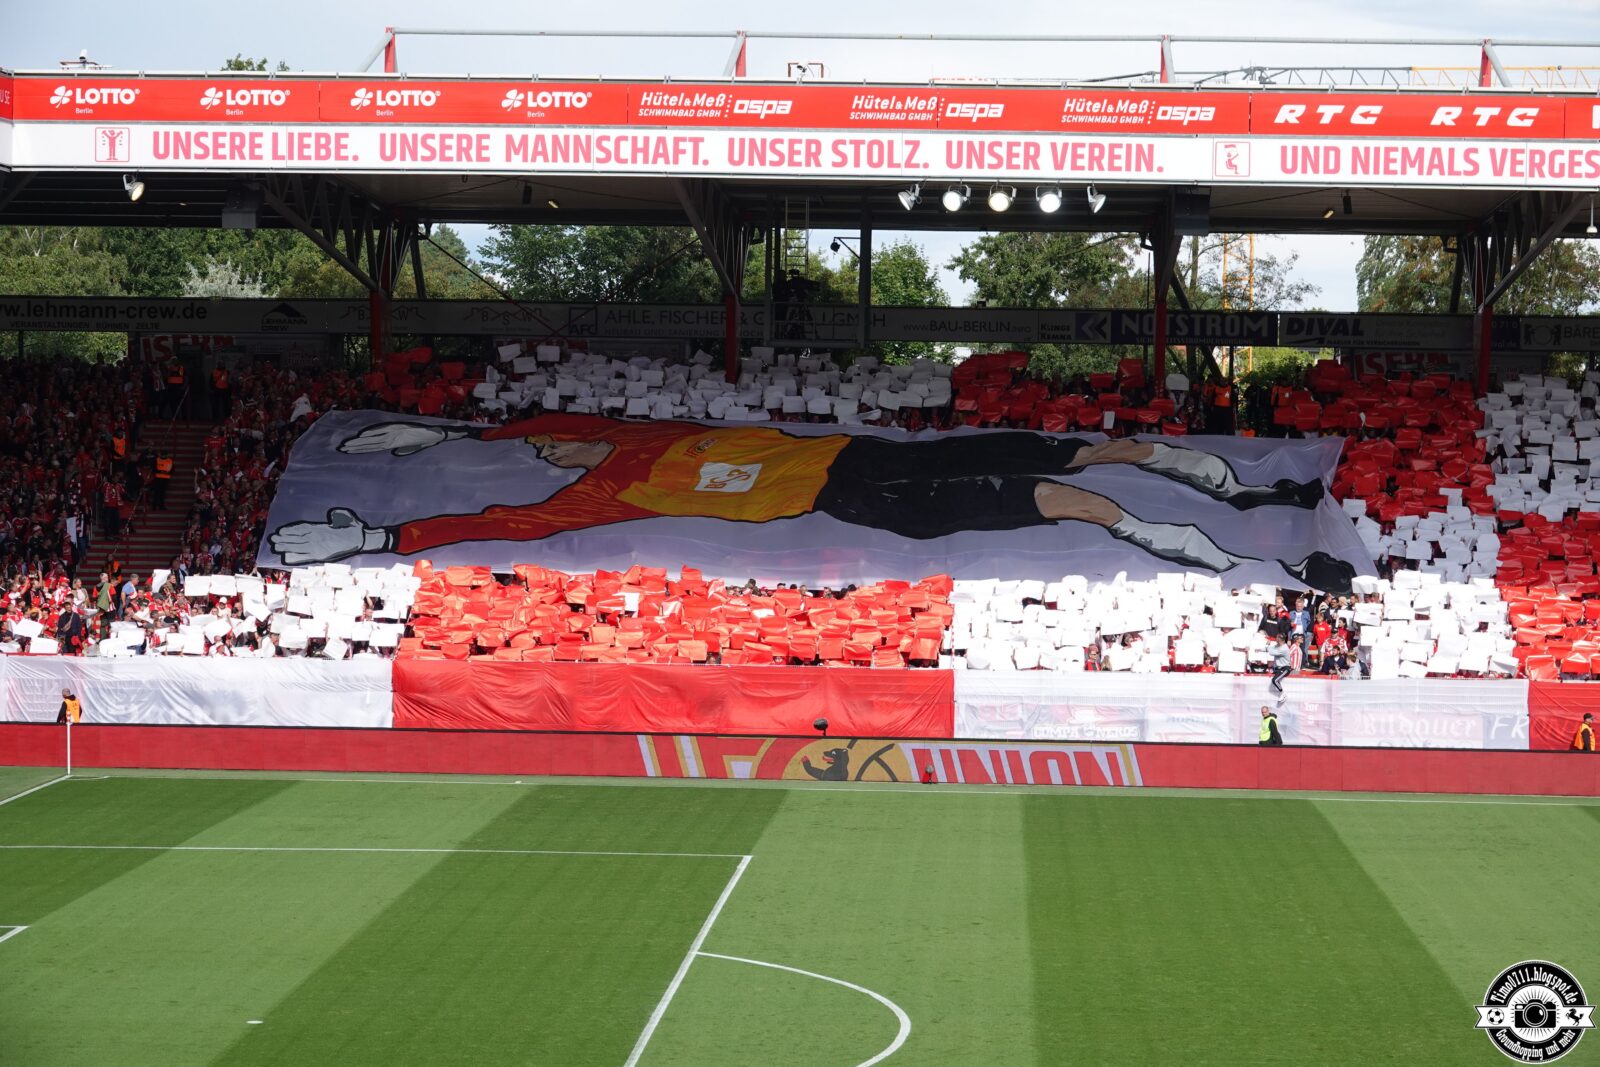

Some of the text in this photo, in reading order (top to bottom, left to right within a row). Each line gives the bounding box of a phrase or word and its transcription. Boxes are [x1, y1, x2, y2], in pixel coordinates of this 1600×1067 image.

[75, 88, 136, 105] LOTTO
[226, 89, 286, 106] LOTTO
[376, 90, 436, 107] LOTTO
[527, 91, 588, 108] LOTTO
[638, 108, 721, 118] SCHWIMMBAD GMBH
[733, 100, 792, 119] ospa
[849, 112, 933, 121] SCHWIMMBAD GMBH
[945, 103, 1005, 122] ospa
[1156, 106, 1216, 126] ospa
[1061, 115, 1145, 124] SCHWIMMBAD GMBH
[152, 131, 1164, 173] UNSERE LIEBE. UNSERE MANNSCHAFT. UNSER STOLZ. UNSER VEREIN.
[1280, 145, 1600, 179] UND NIEMALS VERGES
[1285, 318, 1364, 337] DIVAL
